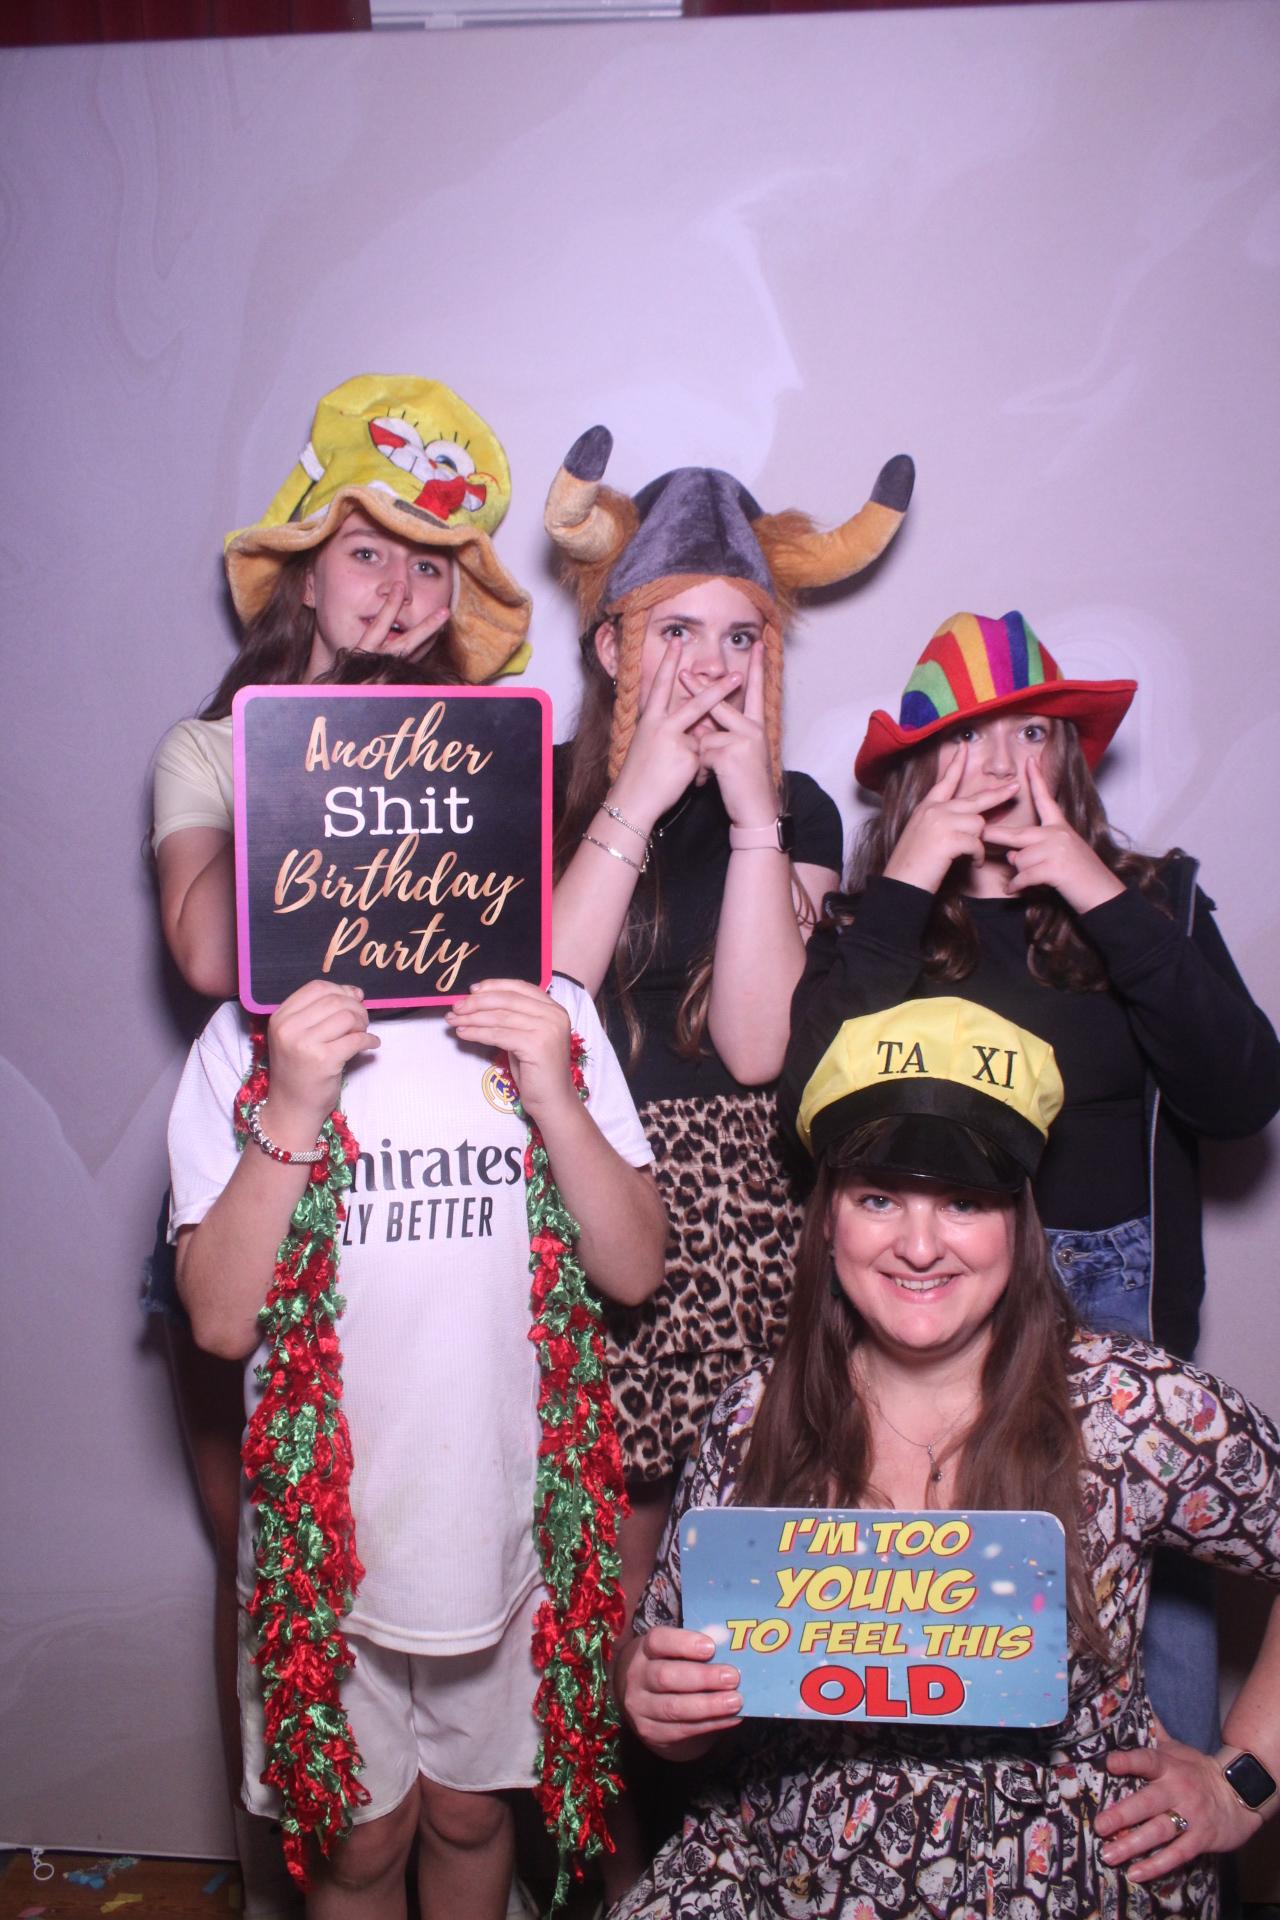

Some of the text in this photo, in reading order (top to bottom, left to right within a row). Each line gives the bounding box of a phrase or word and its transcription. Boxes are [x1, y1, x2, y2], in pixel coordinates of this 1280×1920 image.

[304, 701, 493, 780] Another
[324, 786, 474, 838] Shit
[273, 832, 525, 926] Birthday
[322, 912, 480, 992] Party
[336, 1196, 494, 1246] LY BETTER
[777, 1518, 971, 1557] I'M TOO
[775, 1565, 977, 1614] YOUNG
[727, 1618, 1035, 1660] TO FEEL THIS
[800, 1664, 967, 1718] OLD
